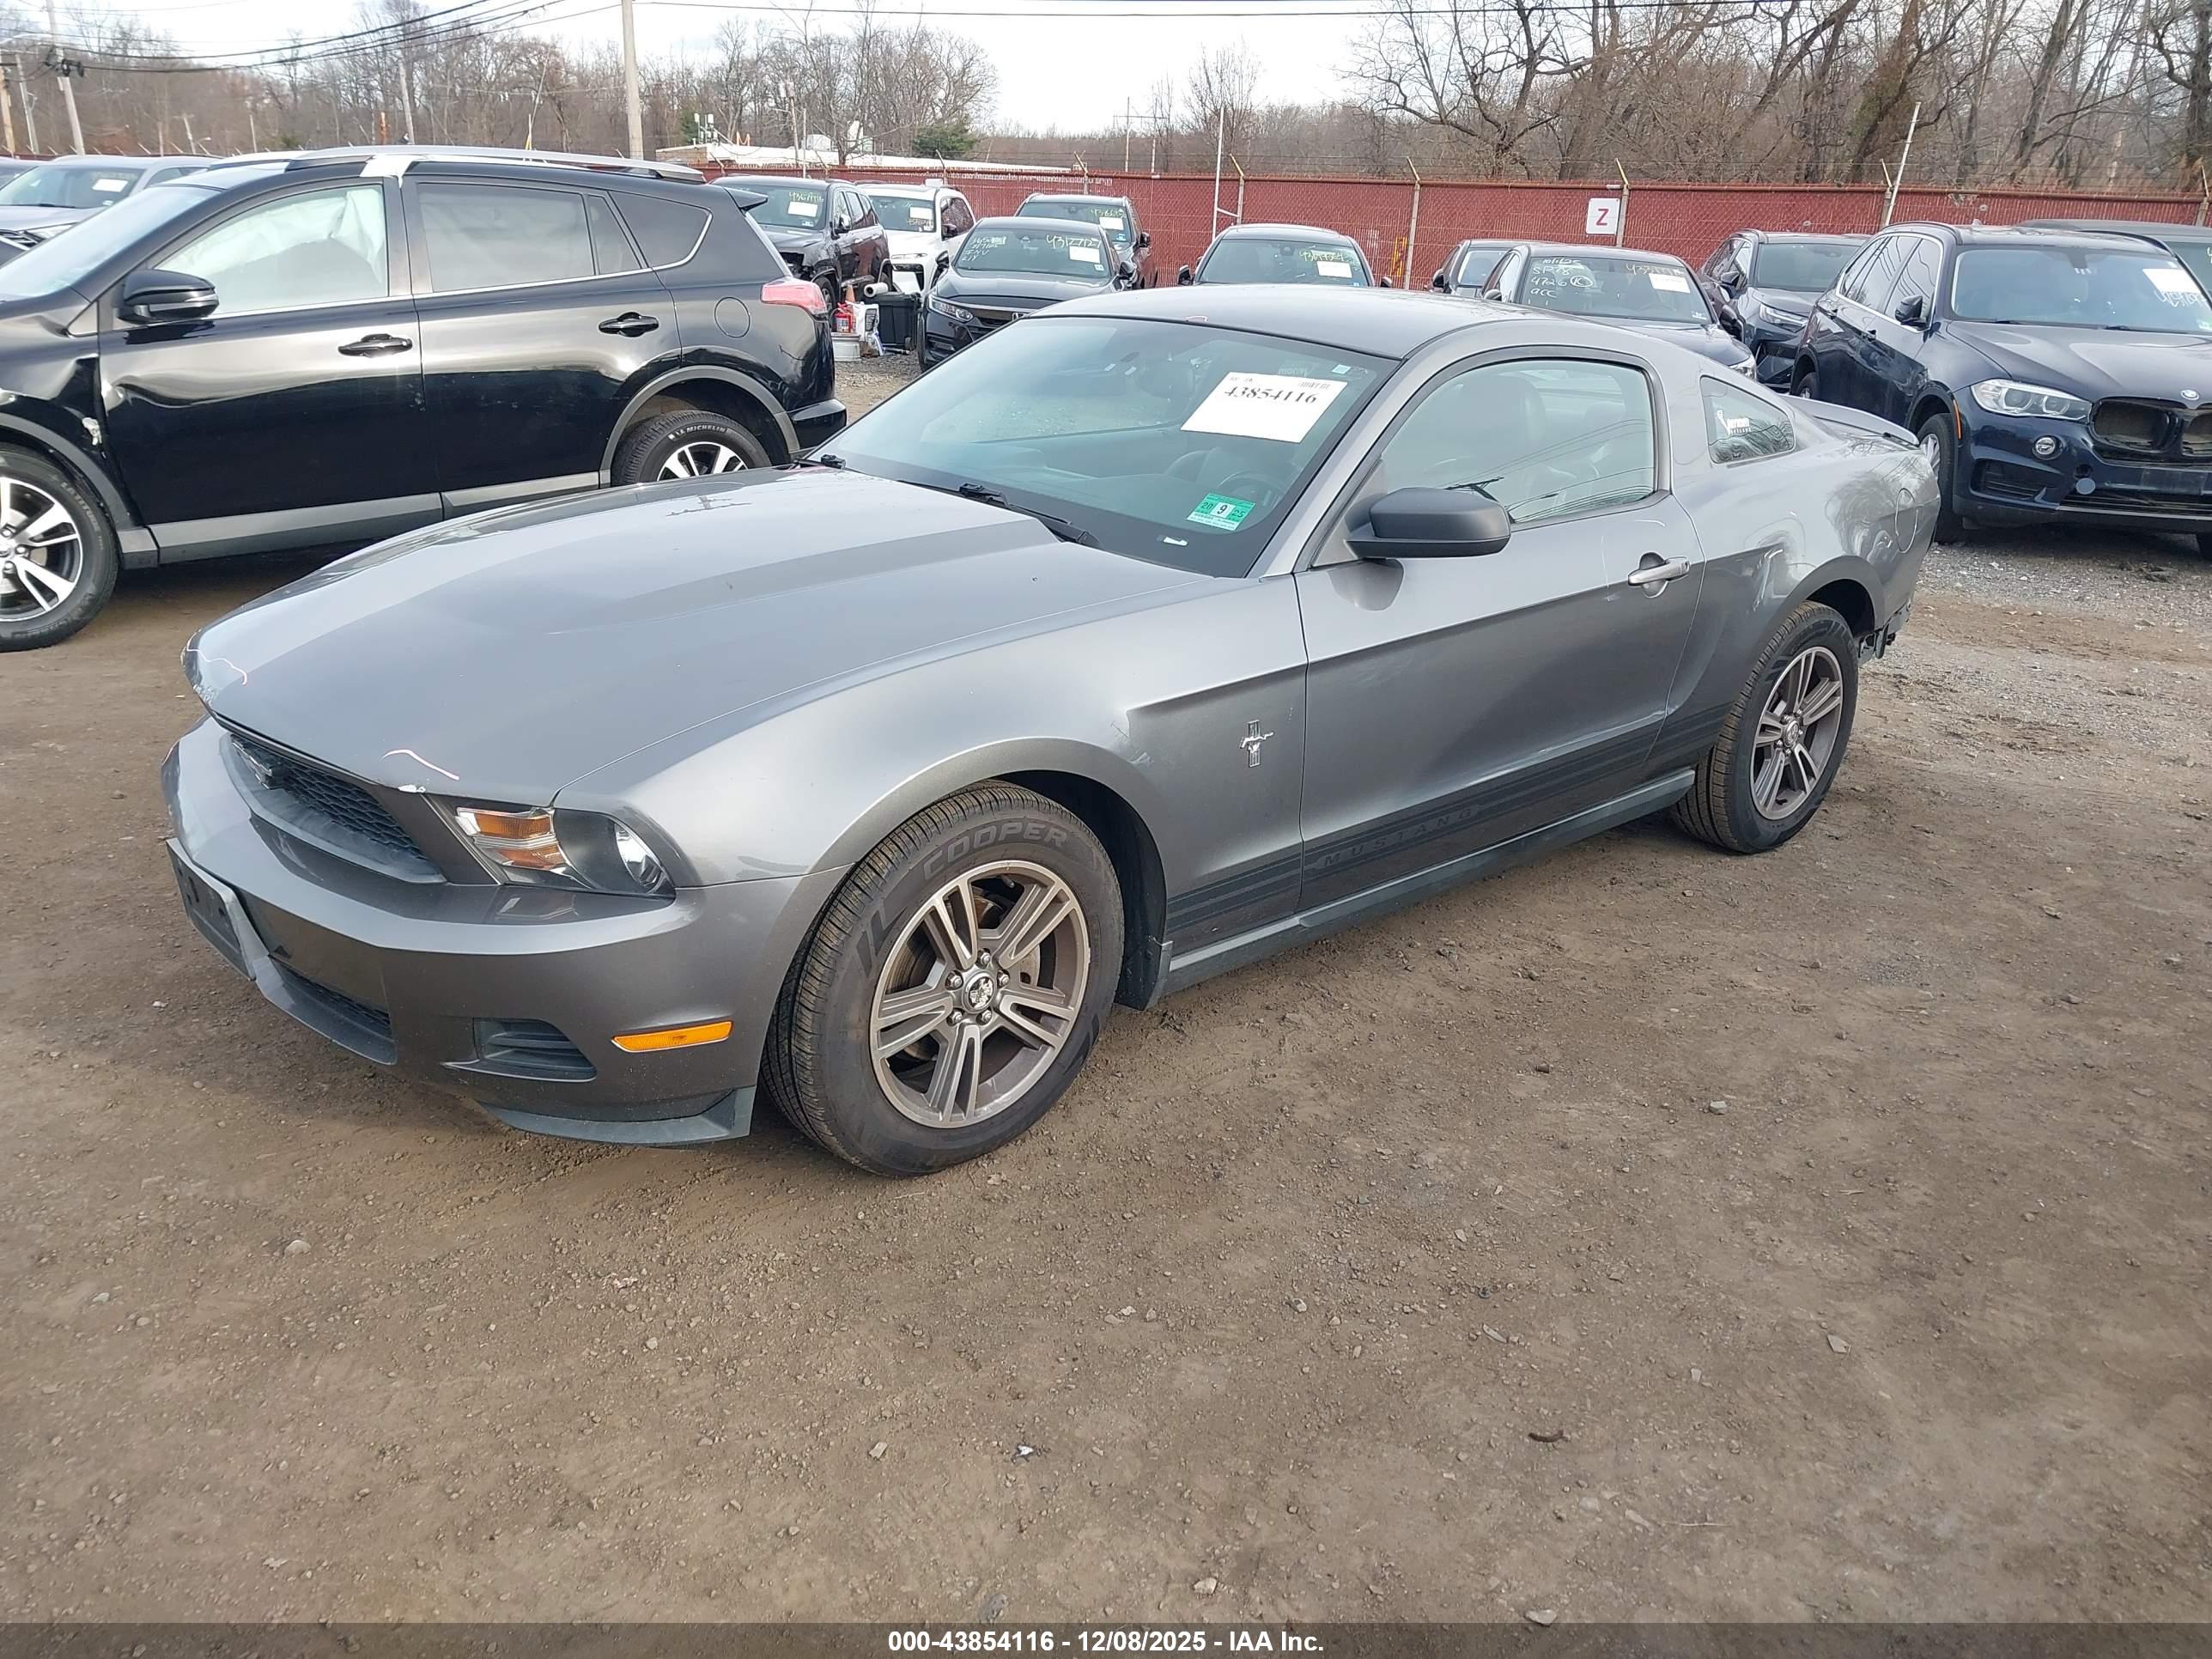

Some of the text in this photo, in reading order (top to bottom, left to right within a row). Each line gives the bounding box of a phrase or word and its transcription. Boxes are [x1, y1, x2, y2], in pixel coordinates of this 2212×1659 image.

[1596, 209, 1608, 226] Z
[1224, 386, 1319, 404] 43854116
[686, 424, 727, 433] MICHELIN
[1217, 504, 1228, 515] 9
[1232, 509, 1246, 518] 25
[1323, 808, 1472, 866] MUSTANG
[923, 822, 1067, 880] COOPER
